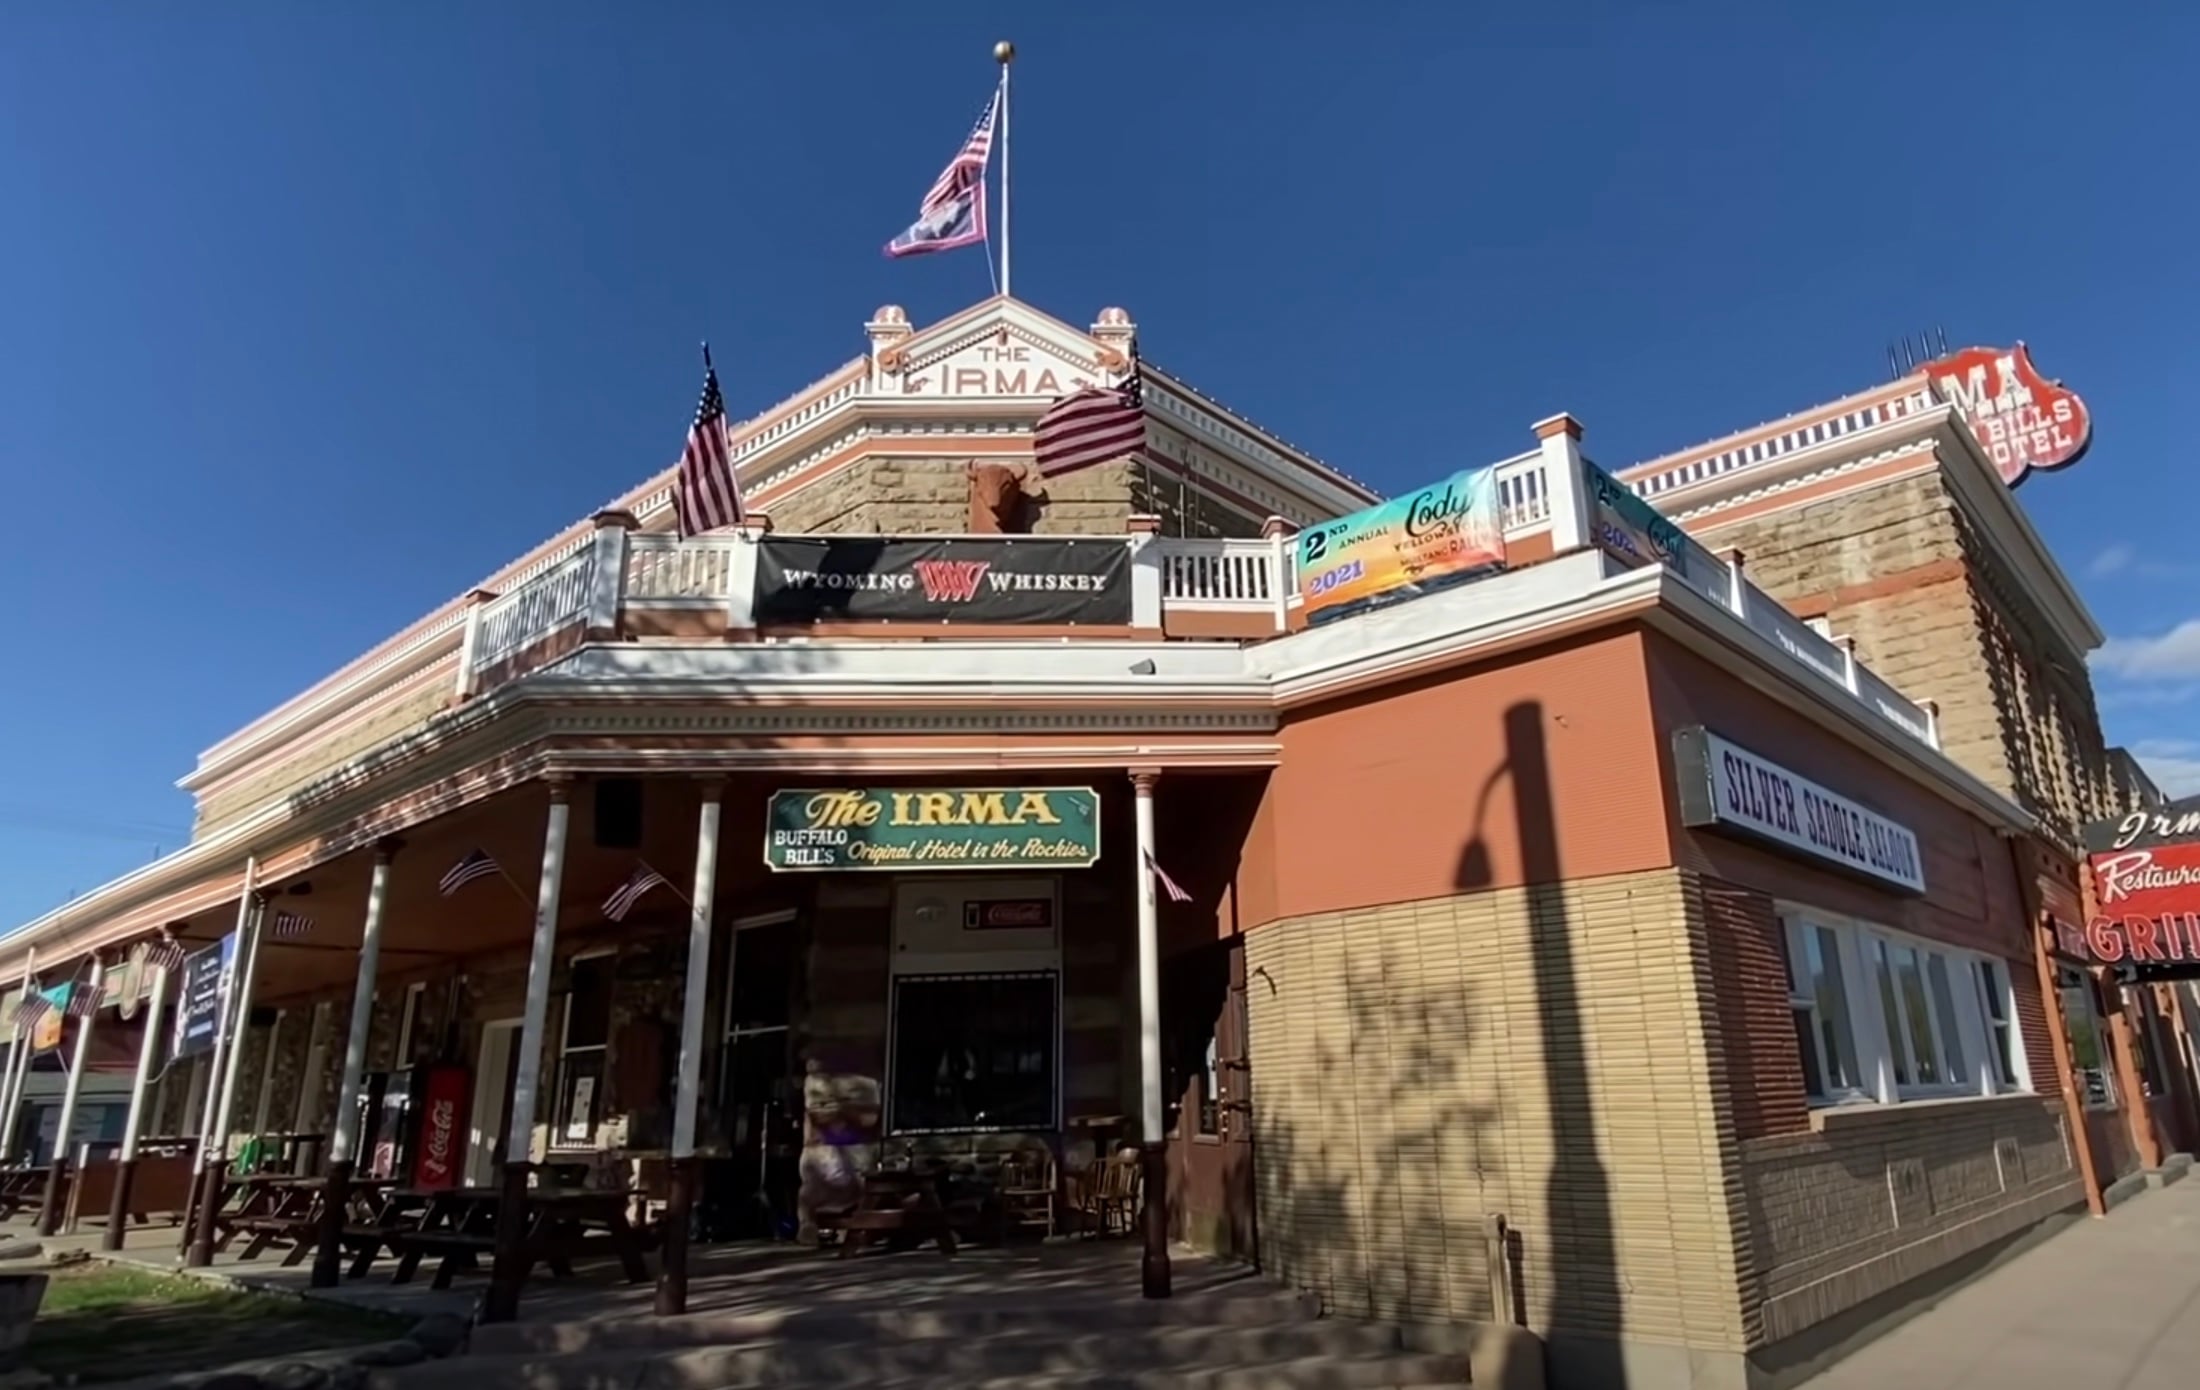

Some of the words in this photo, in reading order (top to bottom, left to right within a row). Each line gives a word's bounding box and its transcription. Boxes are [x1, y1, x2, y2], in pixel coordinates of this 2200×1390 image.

[977, 347, 1030, 362] THE
[941, 363, 1062, 395] IRMA
[1987, 398, 2073, 443] BILLS
[1982, 425, 2073, 465] OTEL
[1405, 484, 1474, 538] Cody
[1339, 526, 1388, 550] ANNUAL
[783, 568, 915, 593] WYOMING
[988, 571, 1107, 593] WHISKEY
[1310, 559, 1363, 596] 2021
[805, 790, 882, 830] The
[889, 792, 1062, 826] IRMA
[1723, 749, 1801, 837] SILVER
[1803, 786, 1866, 863] SADDLE
[1864, 815, 1918, 881] SALOON
[774, 829, 848, 846] BUFFALO
[847, 839, 917, 865] Original
[915, 838, 972, 860] Hotel
[971, 841, 986, 858] in
[990, 838, 1018, 859] the
[1020, 837, 1089, 858] Rockies
